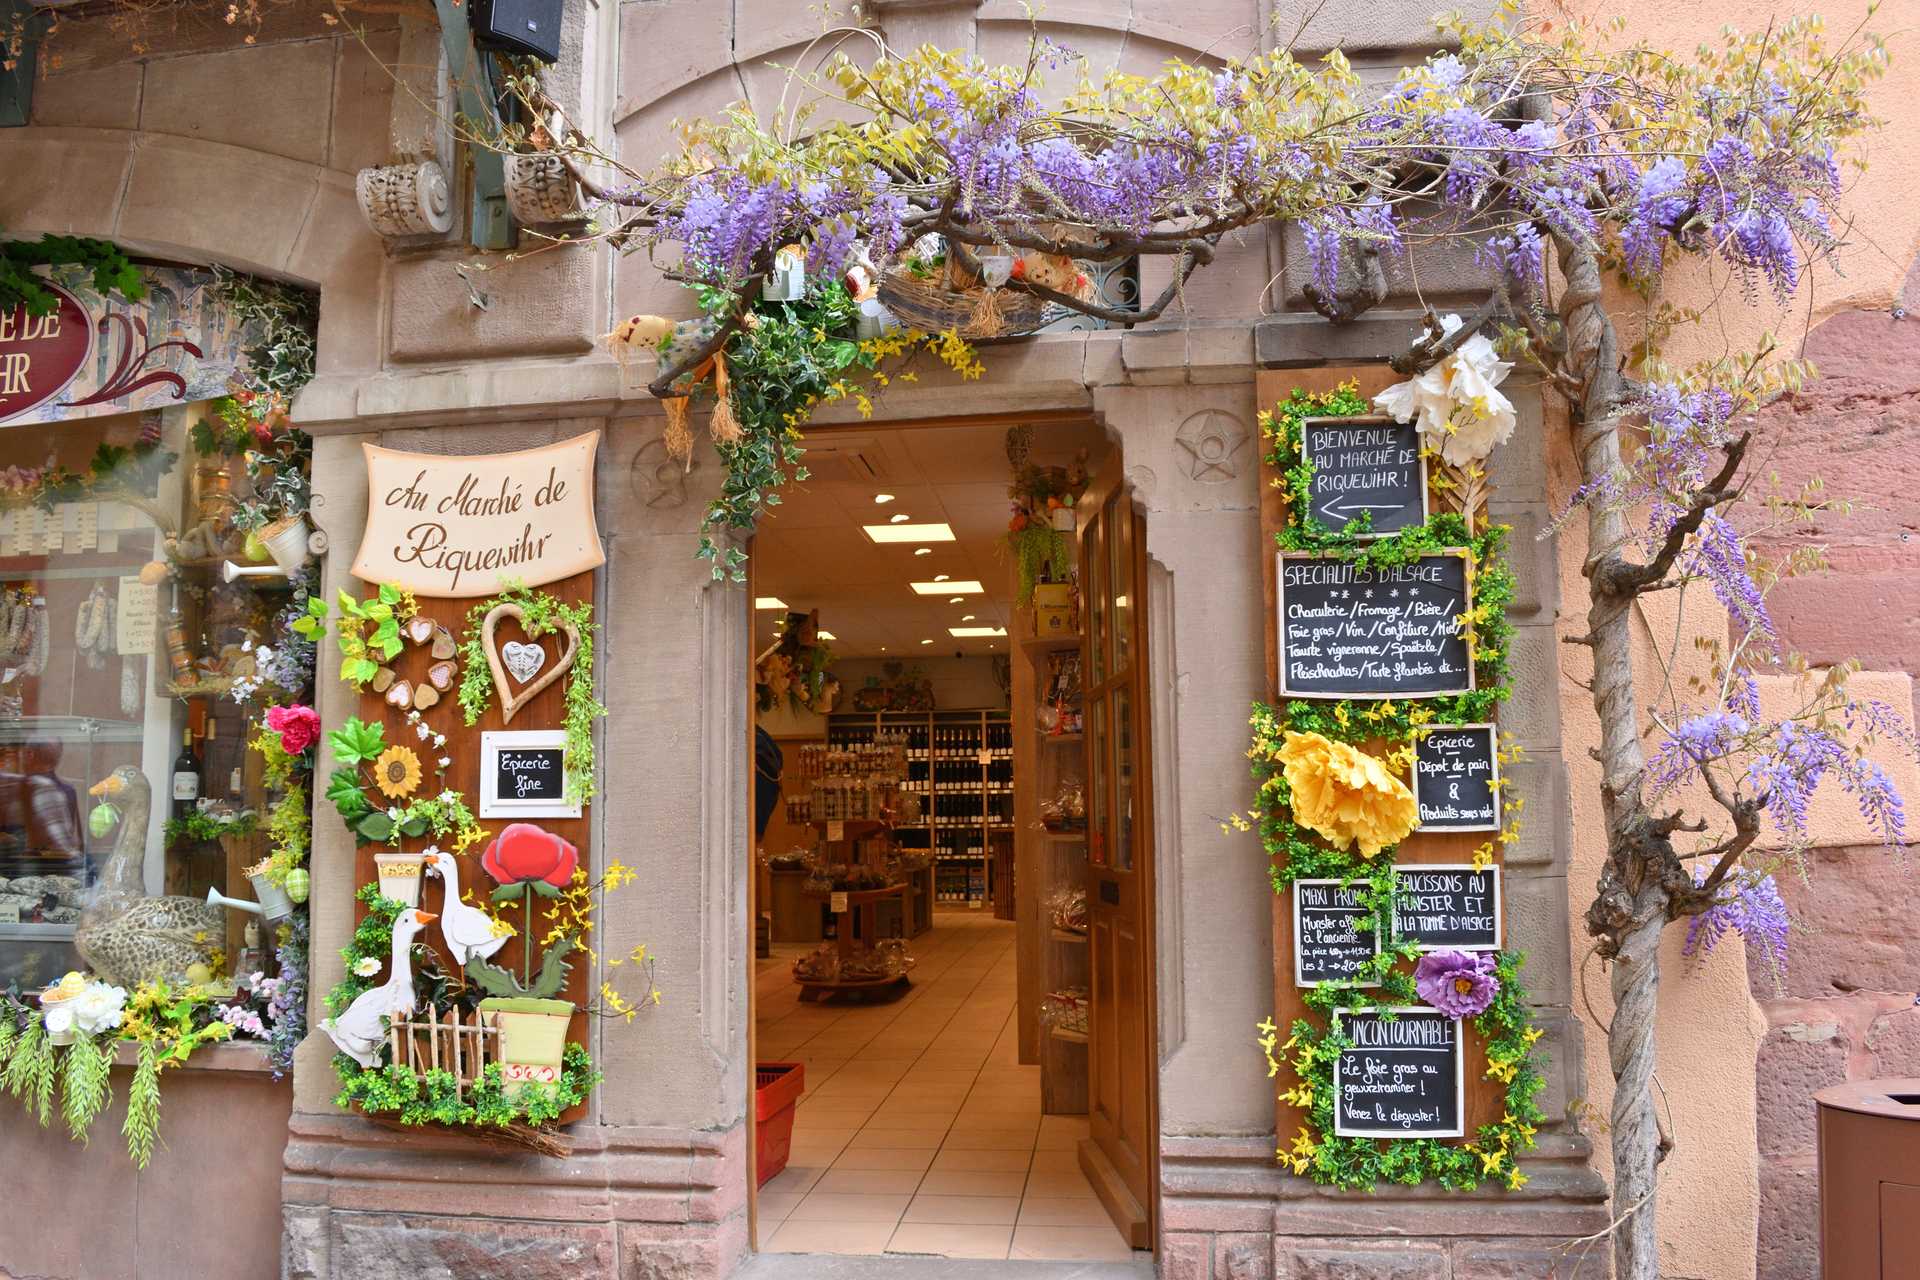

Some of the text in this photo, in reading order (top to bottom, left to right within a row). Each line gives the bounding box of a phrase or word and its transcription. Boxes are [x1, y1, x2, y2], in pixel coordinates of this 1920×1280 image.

[21, 298, 62, 340] DE
[1312, 427, 1398, 451] BIENVENUE
[1315, 446, 1416, 469] AU MARCHÉ DE
[1317, 468, 1399, 493] RIQUEWIHR
[385, 466, 568, 517] Au Marché de
[394, 522, 553, 591] Riquewihr
[1288, 601, 1349, 619] Charcuterie
[1358, 603, 1404, 623] Fromage
[1288, 624, 1311, 640] Foie
[1313, 627, 1335, 642] gras
[1346, 621, 1367, 637] Vin
[1378, 620, 1429, 642] Confiture
[1286, 641, 1322, 658] Tourte
[1326, 642, 1381, 662] vigneronne
[1365, 661, 1391, 678] Tarte
[1393, 660, 1436, 681] flambée
[1427, 736, 1475, 754] Epicerie
[1452, 757, 1466, 772] de
[1468, 759, 1490, 777] pain
[515, 775, 544, 798] fine
[1449, 782, 1460, 800] &
[1419, 803, 1495, 821] Produits sous vide
[1396, 872, 1485, 893] SAUCISSONS AU
[1301, 886, 1328, 906] MAXI
[1397, 894, 1485, 914] MUNSTER ET
[1302, 914, 1336, 931] Munster
[1403, 916, 1416, 931] LA
[1416, 915, 1448, 931] TOMME
[1450, 915, 1494, 931] D'ALSACE
[1316, 929, 1360, 944] l'ancienne
[1301, 958, 1316, 971] Les
[1317, 959, 1325, 971] 2
[1347, 1018, 1455, 1046] 'INCONTOURNABLE
[1342, 1055, 1439, 1084] Le foie gras au
[1344, 1080, 1416, 1101] gewurztraminer
[1344, 1102, 1372, 1120] Venez
[1376, 1103, 1387, 1121] le
